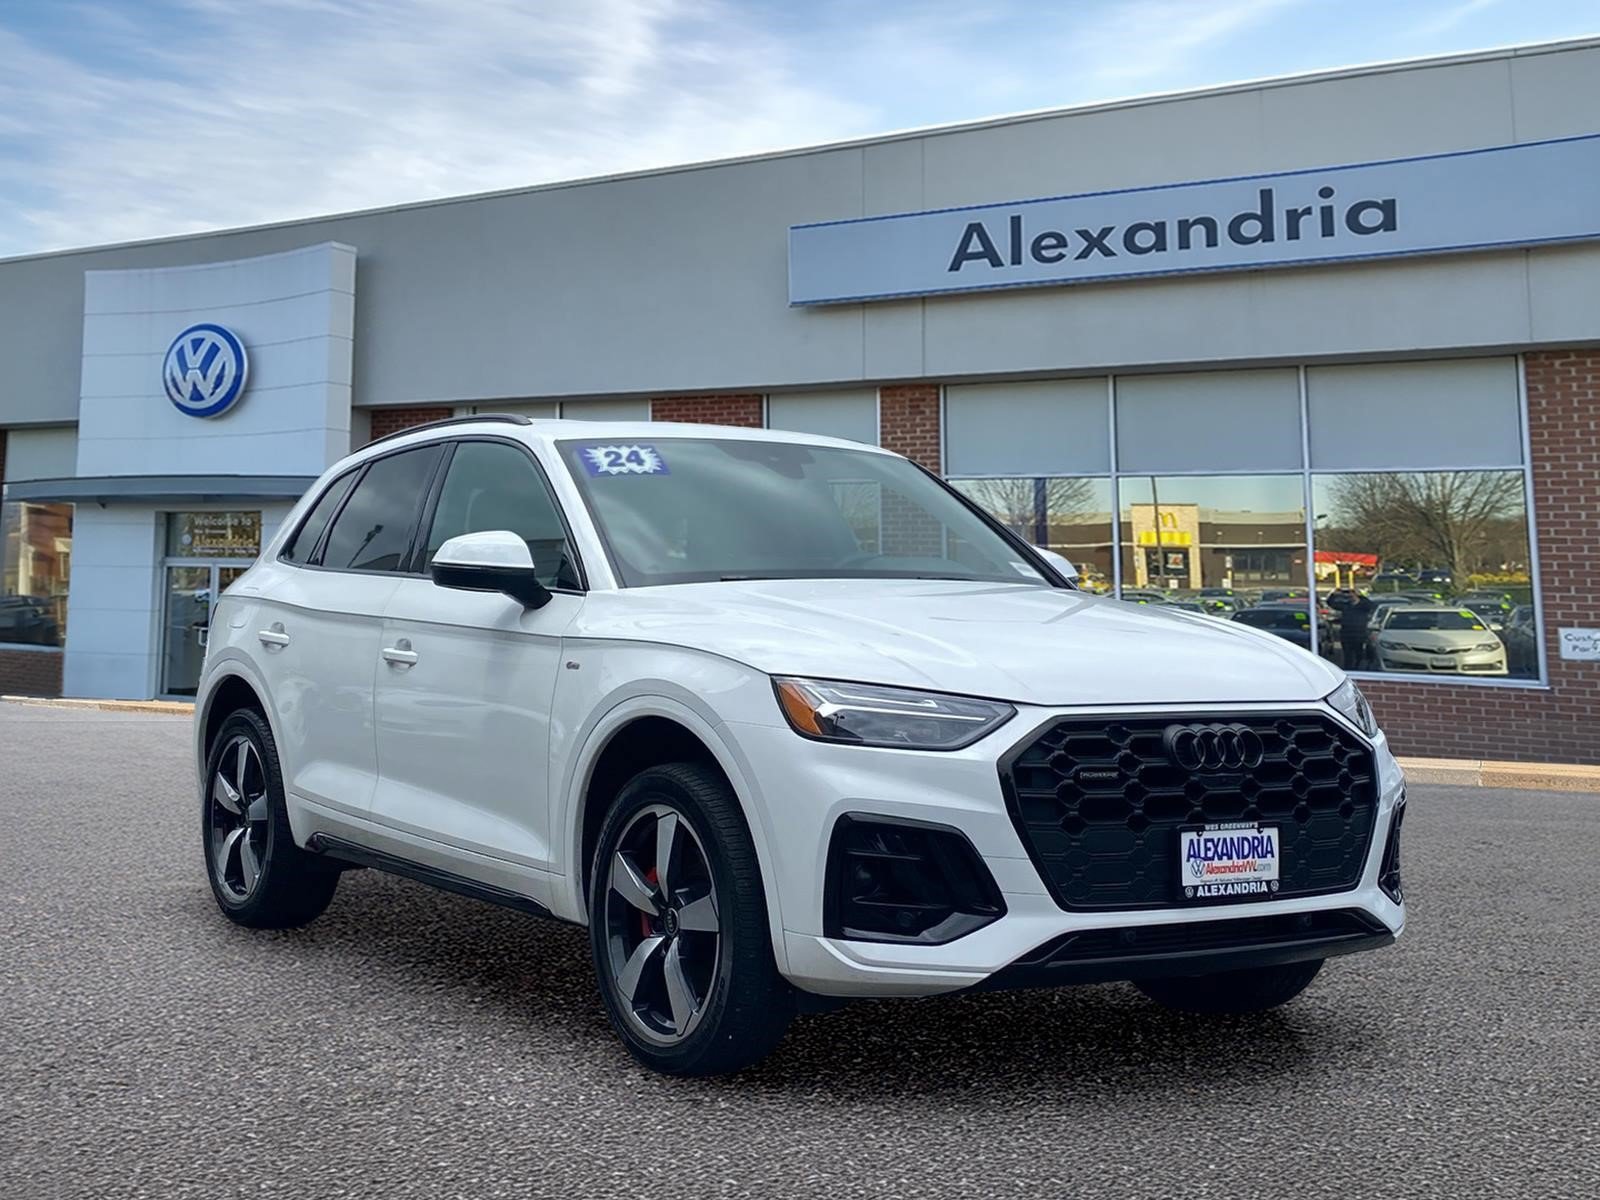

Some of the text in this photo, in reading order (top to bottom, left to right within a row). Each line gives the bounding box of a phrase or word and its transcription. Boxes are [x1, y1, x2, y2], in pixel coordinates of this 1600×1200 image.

[947, 186, 1398, 273] Alexandria
[603, 449, 646, 468] 24
[1186, 835, 1275, 862] ALEXANDRIA
[1196, 881, 1268, 898] ALEXANDRIA
